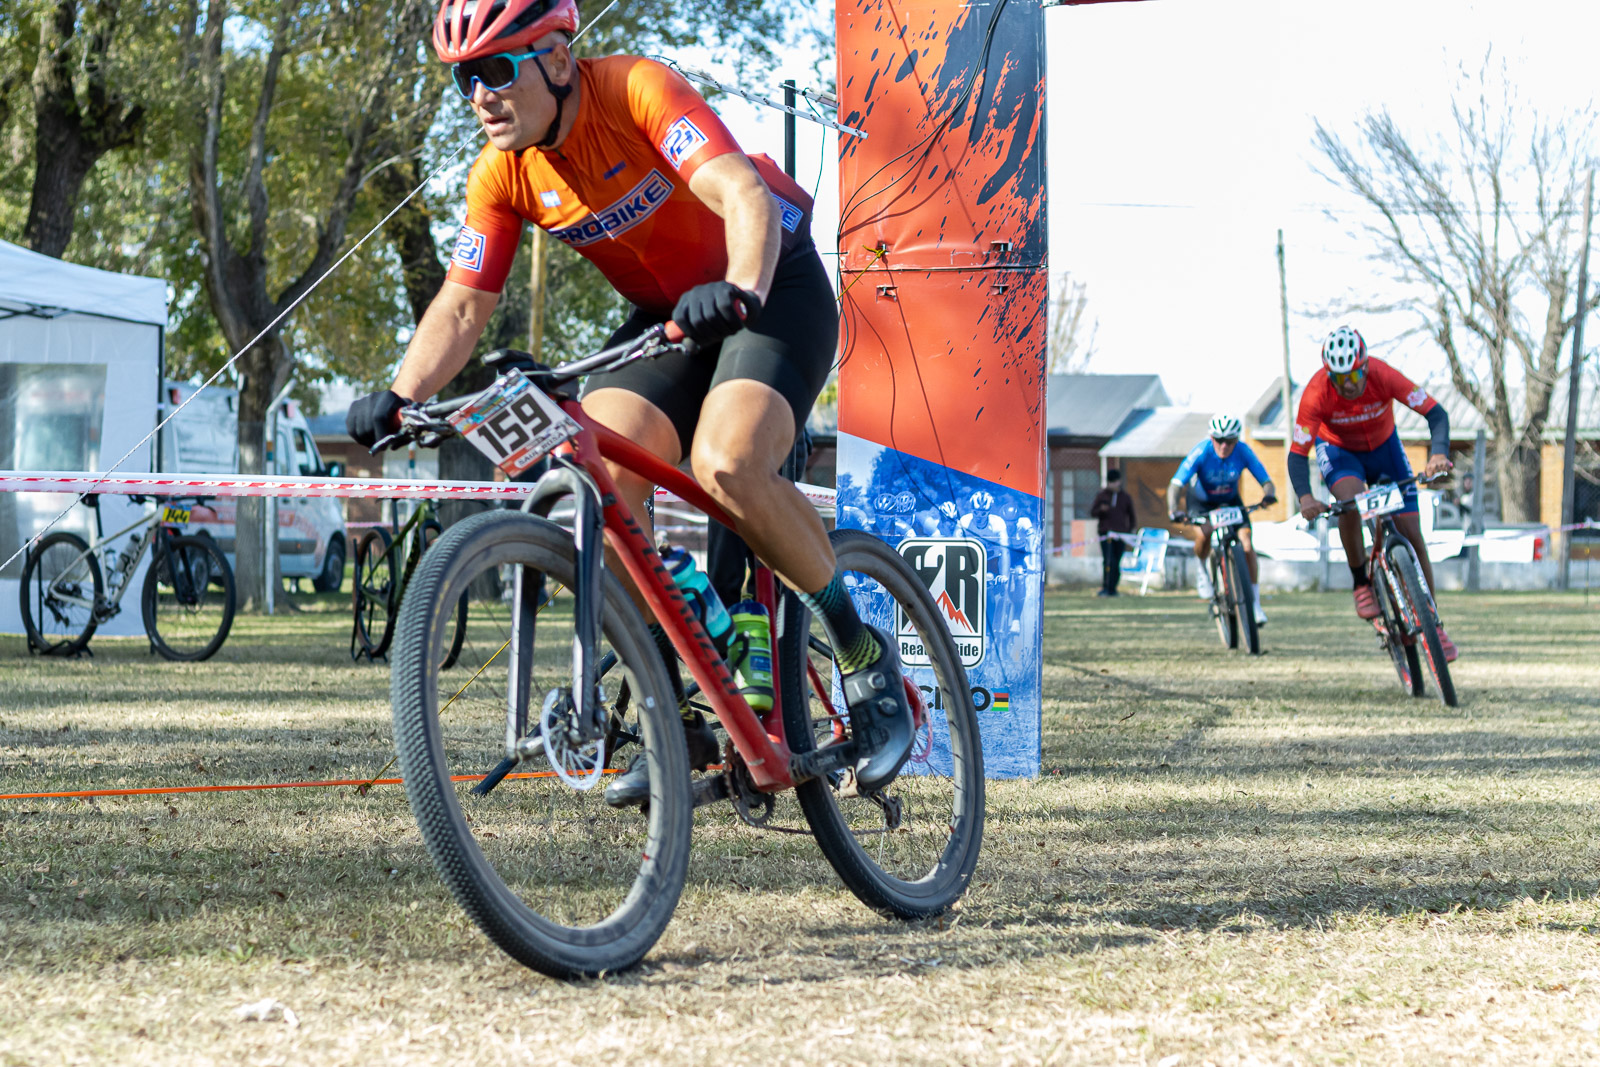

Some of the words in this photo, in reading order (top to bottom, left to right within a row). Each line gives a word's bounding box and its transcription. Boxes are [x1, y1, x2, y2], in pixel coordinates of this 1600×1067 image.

[551, 178, 669, 242] PROBIKE
[476, 393, 552, 458] 159
[955, 643, 979, 657] ide
